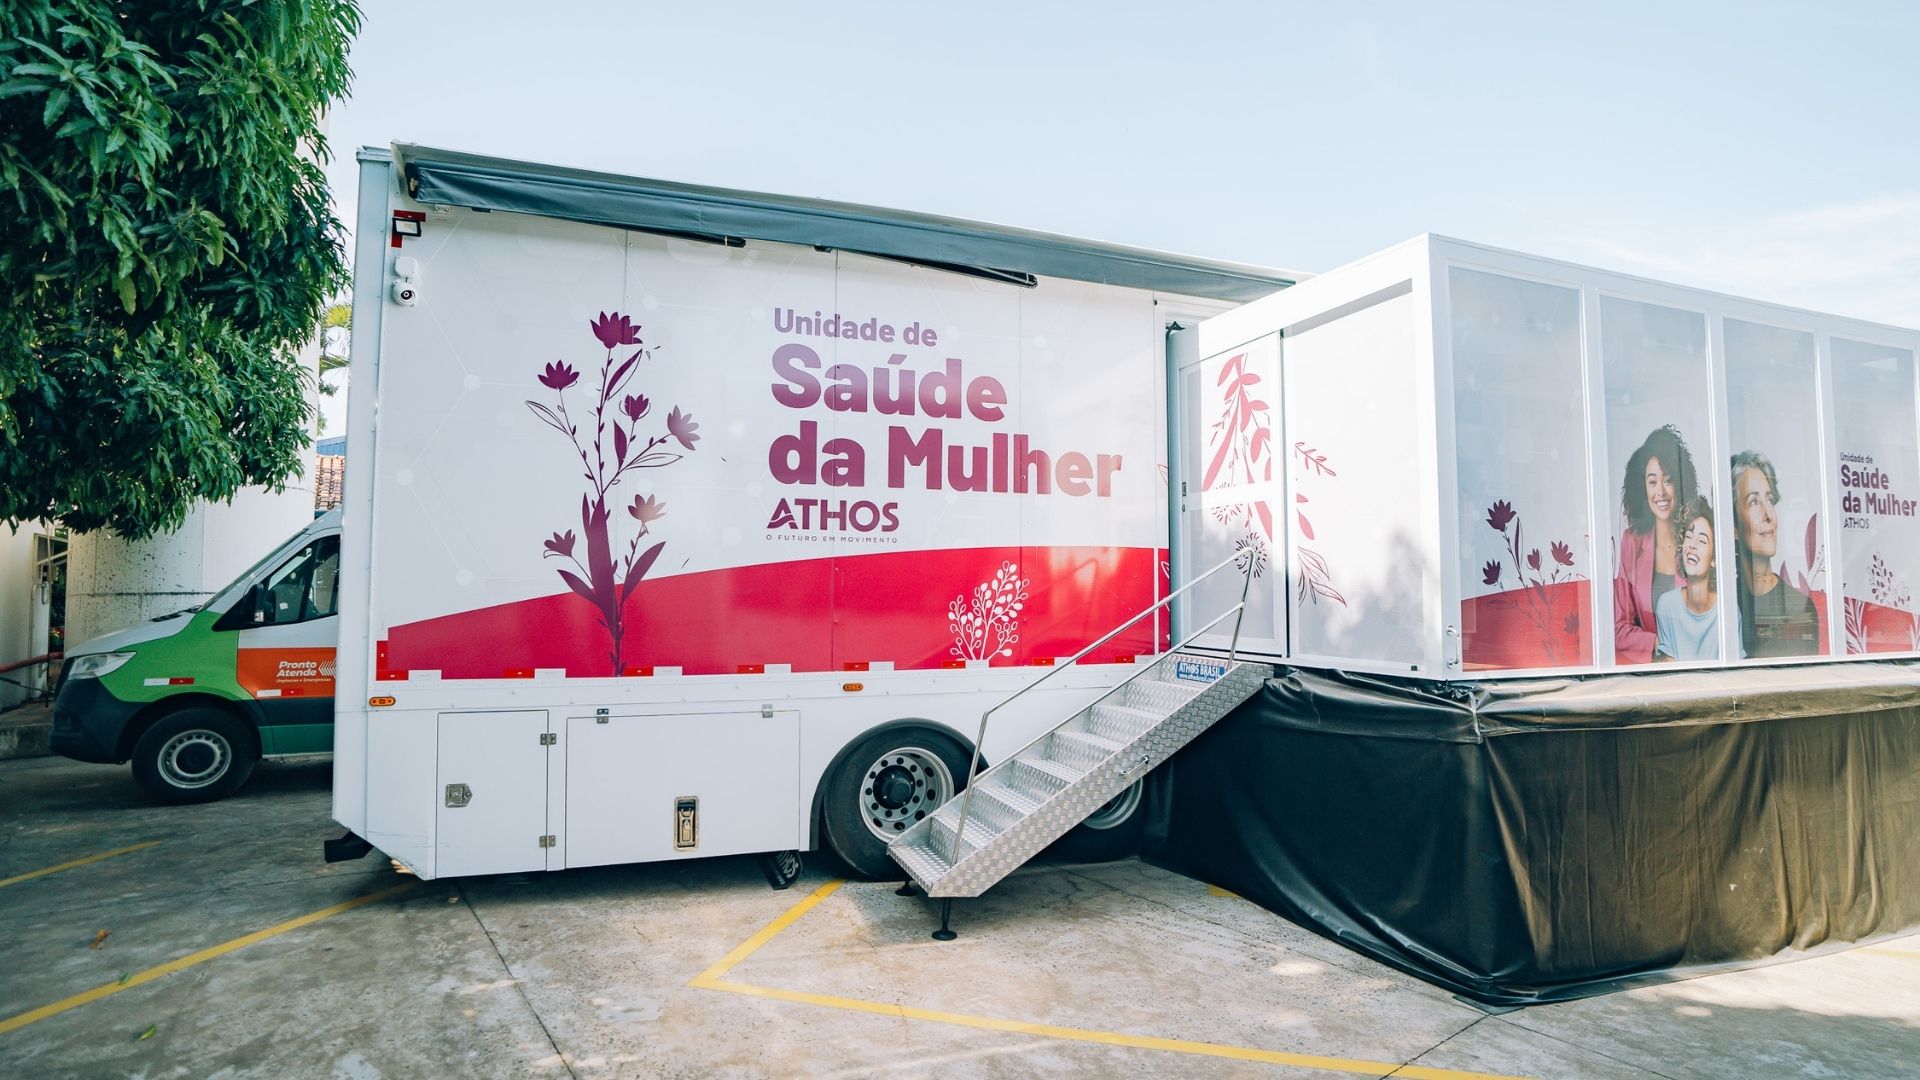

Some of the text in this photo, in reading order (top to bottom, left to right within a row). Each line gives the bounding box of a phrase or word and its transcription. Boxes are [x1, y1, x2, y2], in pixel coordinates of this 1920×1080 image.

[774, 307, 938, 347] Unidade de
[771, 343, 1008, 422] Saúde
[768, 420, 1123, 497] da Mulher
[1840, 452, 1873, 464] Unidade de
[1841, 464, 1889, 490] Saúde
[767, 497, 899, 532] ATHOS
[1842, 490, 1917, 517] da Mulher
[1843, 518, 1869, 529] ATHOS
[778, 534, 818, 542] FUTURO
[277, 669, 317, 677] Atende
[1178, 662, 1199, 675] ATHOS
